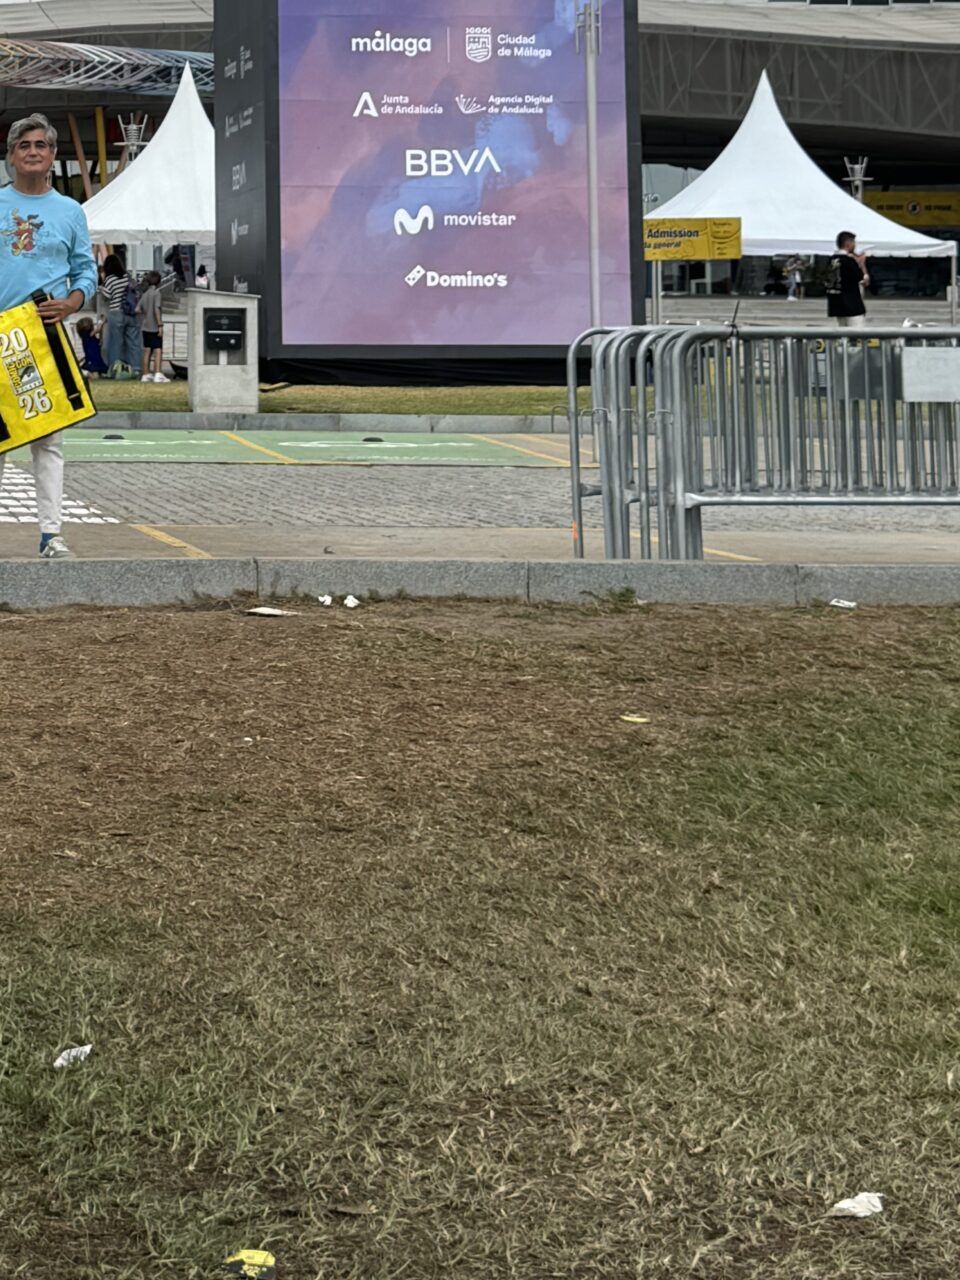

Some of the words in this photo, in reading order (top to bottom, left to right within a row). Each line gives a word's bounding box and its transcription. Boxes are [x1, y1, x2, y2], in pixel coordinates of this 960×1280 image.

[497, 34, 536, 45] Ciudad
[497, 47, 512, 57] de
[514, 46, 552, 58] Málaga
[381, 95, 409, 104] Junta
[488, 95, 522, 106] Agencia
[525, 95, 553, 105] Digital
[381, 105, 393, 114] de
[395, 104, 443, 114] Andalucía
[501, 104, 544, 114] Andalucía
[405, 146, 502, 176] BBVA
[444, 212, 516, 226] movistar
[647, 228, 699, 239] Admission
[426, 271, 507, 287] Domino's
[19, 389, 52, 419] 26
